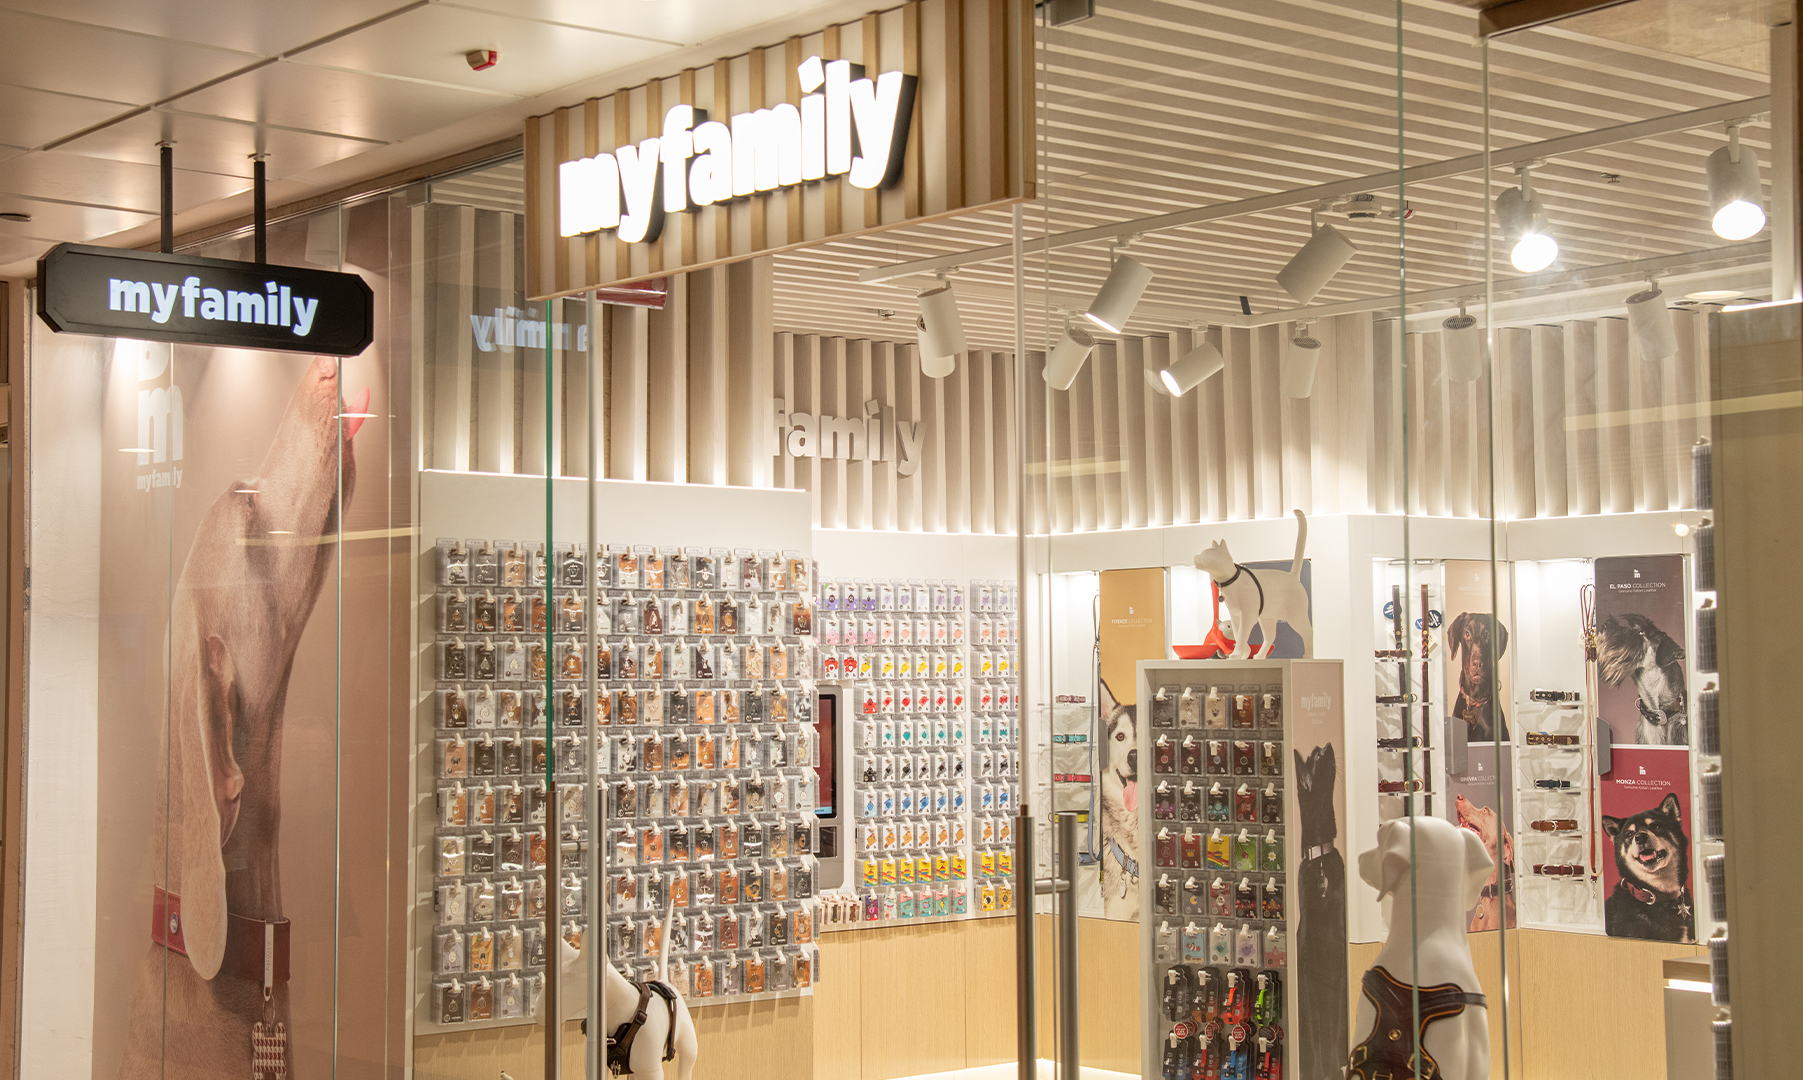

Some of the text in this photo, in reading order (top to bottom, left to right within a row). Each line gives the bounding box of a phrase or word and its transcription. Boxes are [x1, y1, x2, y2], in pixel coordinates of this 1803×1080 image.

[560, 55, 903, 243] myfamily
[109, 276, 319, 336] myfamily
[1301, 692, 1331, 711] myfamily
